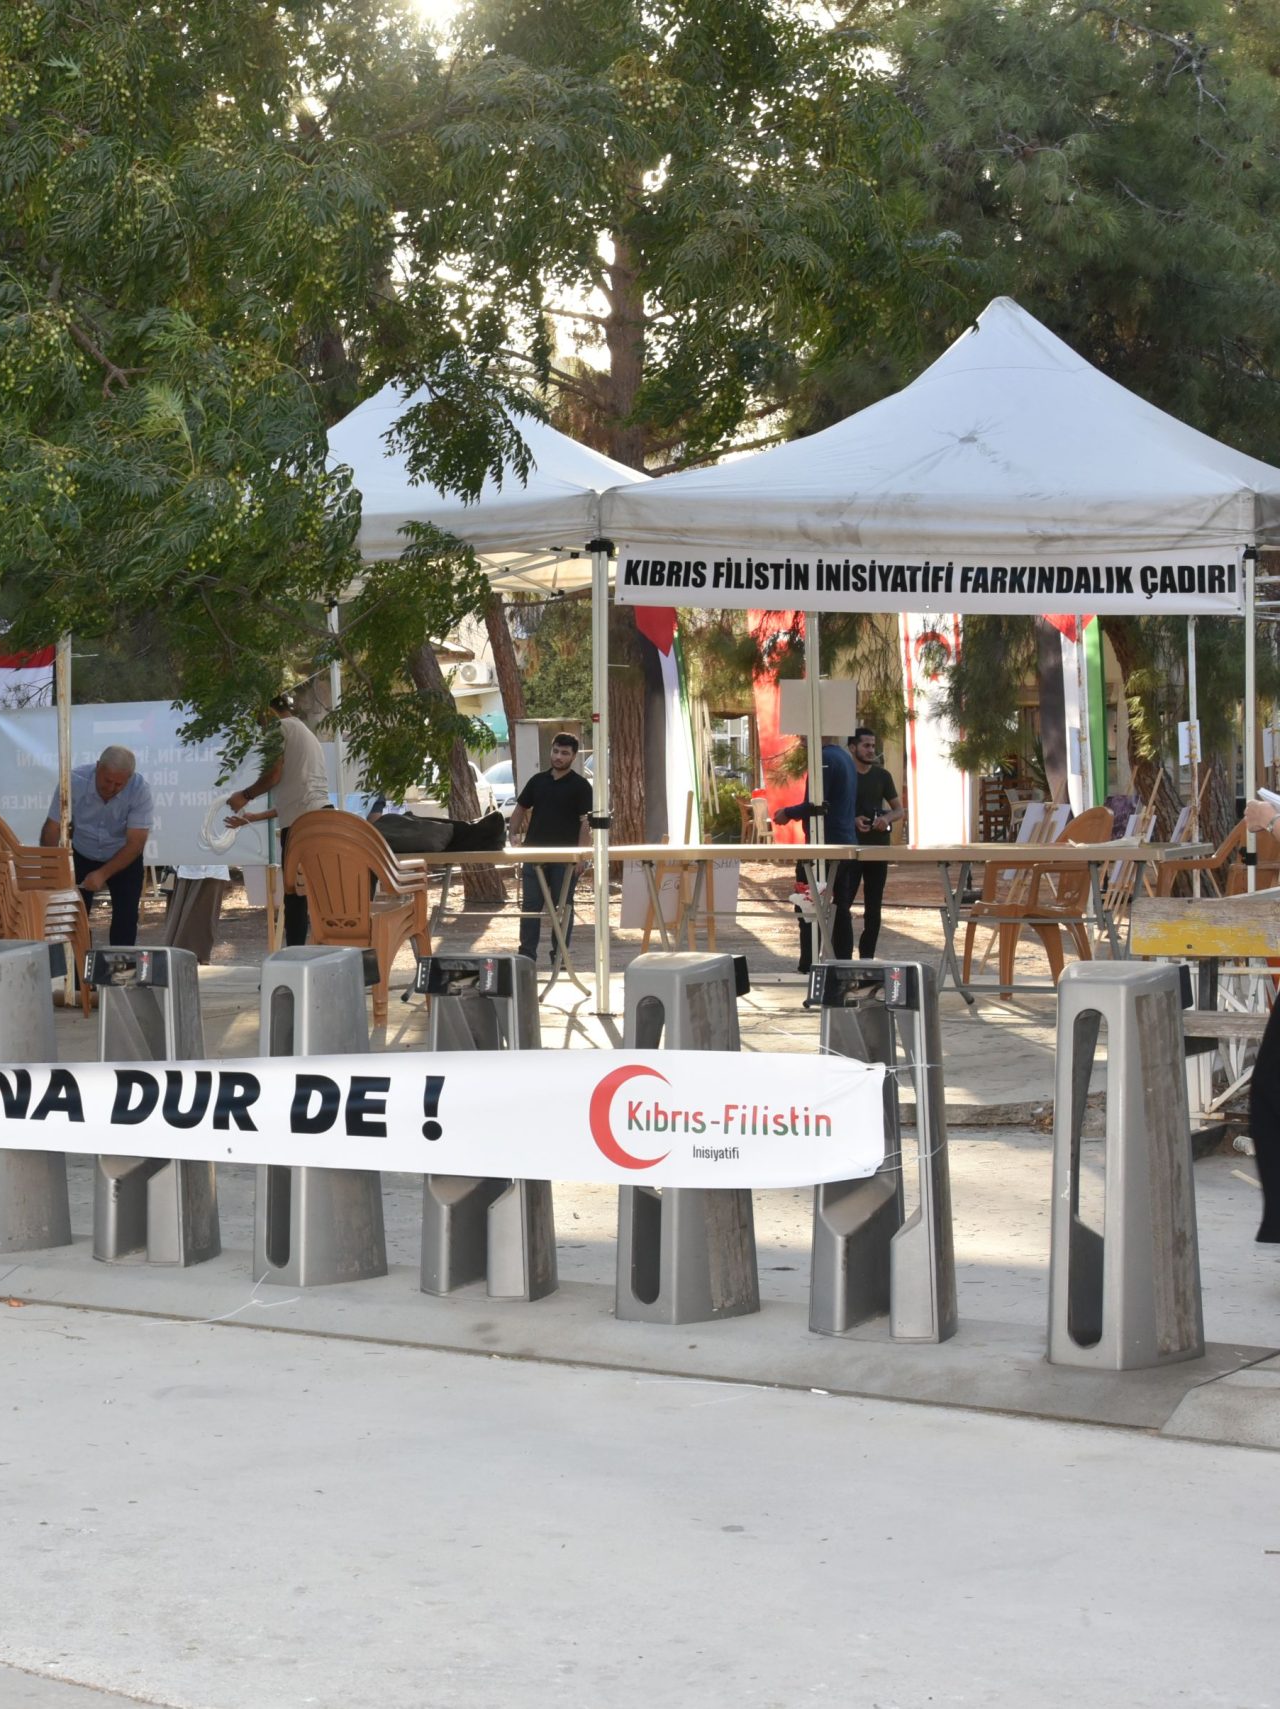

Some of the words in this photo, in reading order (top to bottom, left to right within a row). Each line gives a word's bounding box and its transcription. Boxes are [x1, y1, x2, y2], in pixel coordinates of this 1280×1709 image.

[624, 559, 707, 588] KIBRIS
[712, 557, 809, 590] FİLİSTİN
[816, 558, 954, 593] İNİSİYATİFİ
[960, 566, 1134, 594] FARKINDALIK
[1140, 564, 1236, 599] ÇADIRI
[110, 1069, 261, 1132] DUR
[290, 1074, 391, 1138] DE
[422, 1075, 446, 1142] !
[626, 1100, 832, 1138] Kıbrıs-Filistin
